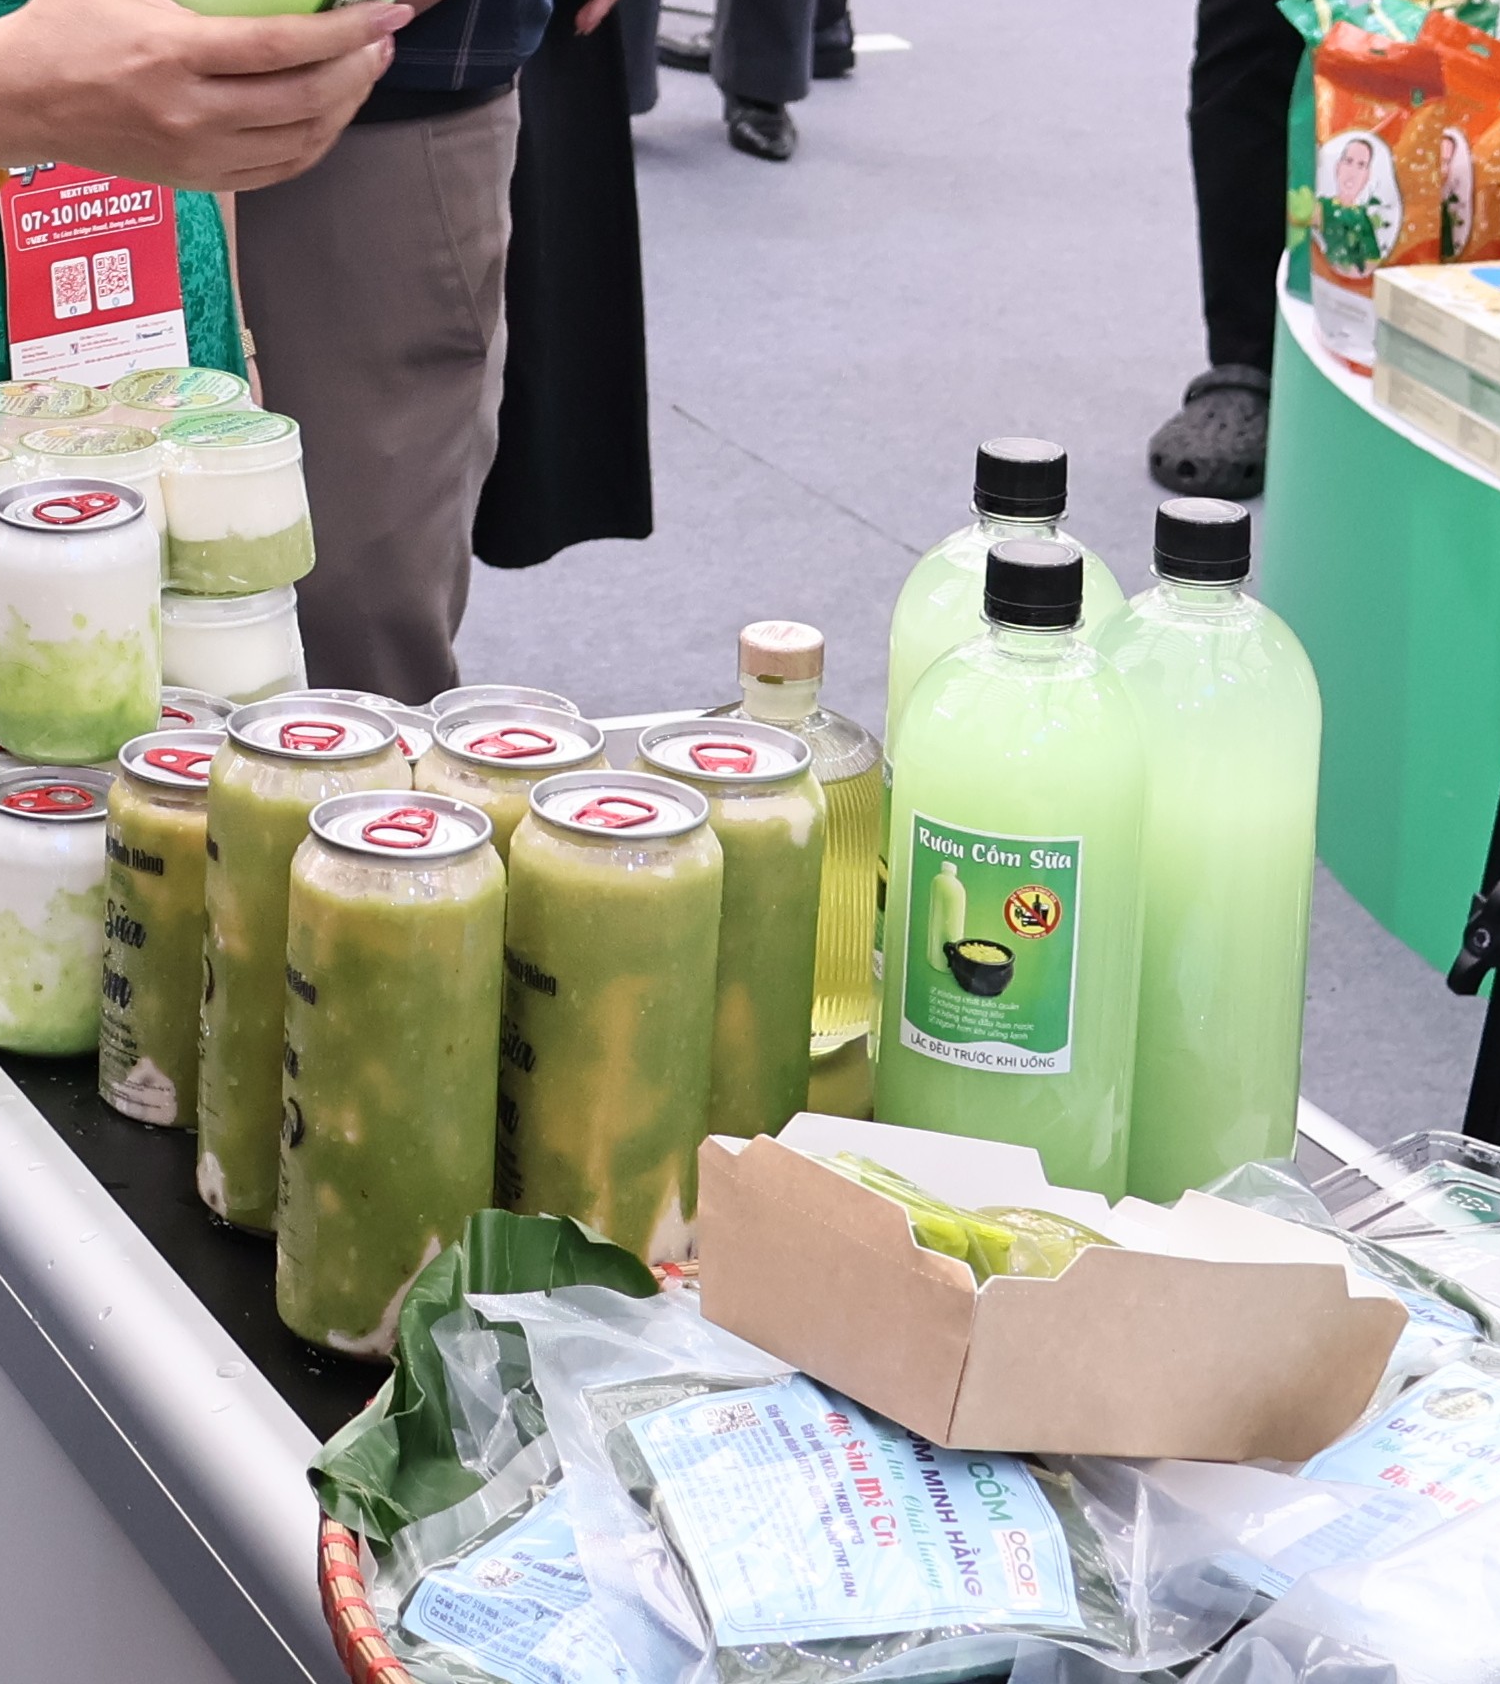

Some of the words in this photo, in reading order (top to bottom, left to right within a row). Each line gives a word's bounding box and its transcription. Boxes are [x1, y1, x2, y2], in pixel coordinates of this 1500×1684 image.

[59, 186, 83, 200] NEXT
[83, 181, 110, 197] EVENT
[918, 826, 965, 860] Rượu
[970, 842, 1022, 868] Cốm
[1029, 848, 1073, 870] Sữa
[953, 1042, 994, 1066] TRƯỚC
[996, 1055, 1018, 1069] KHI
[1020, 1050, 1056, 1068] UỐNG
[841, 1438, 869, 1473] Sản
[966, 1460, 1014, 1522] CỐM
[919, 1468, 959, 1524] MINH
[944, 1529, 983, 1598] HẰNG
[1007, 1529, 1039, 1598] OCOP
